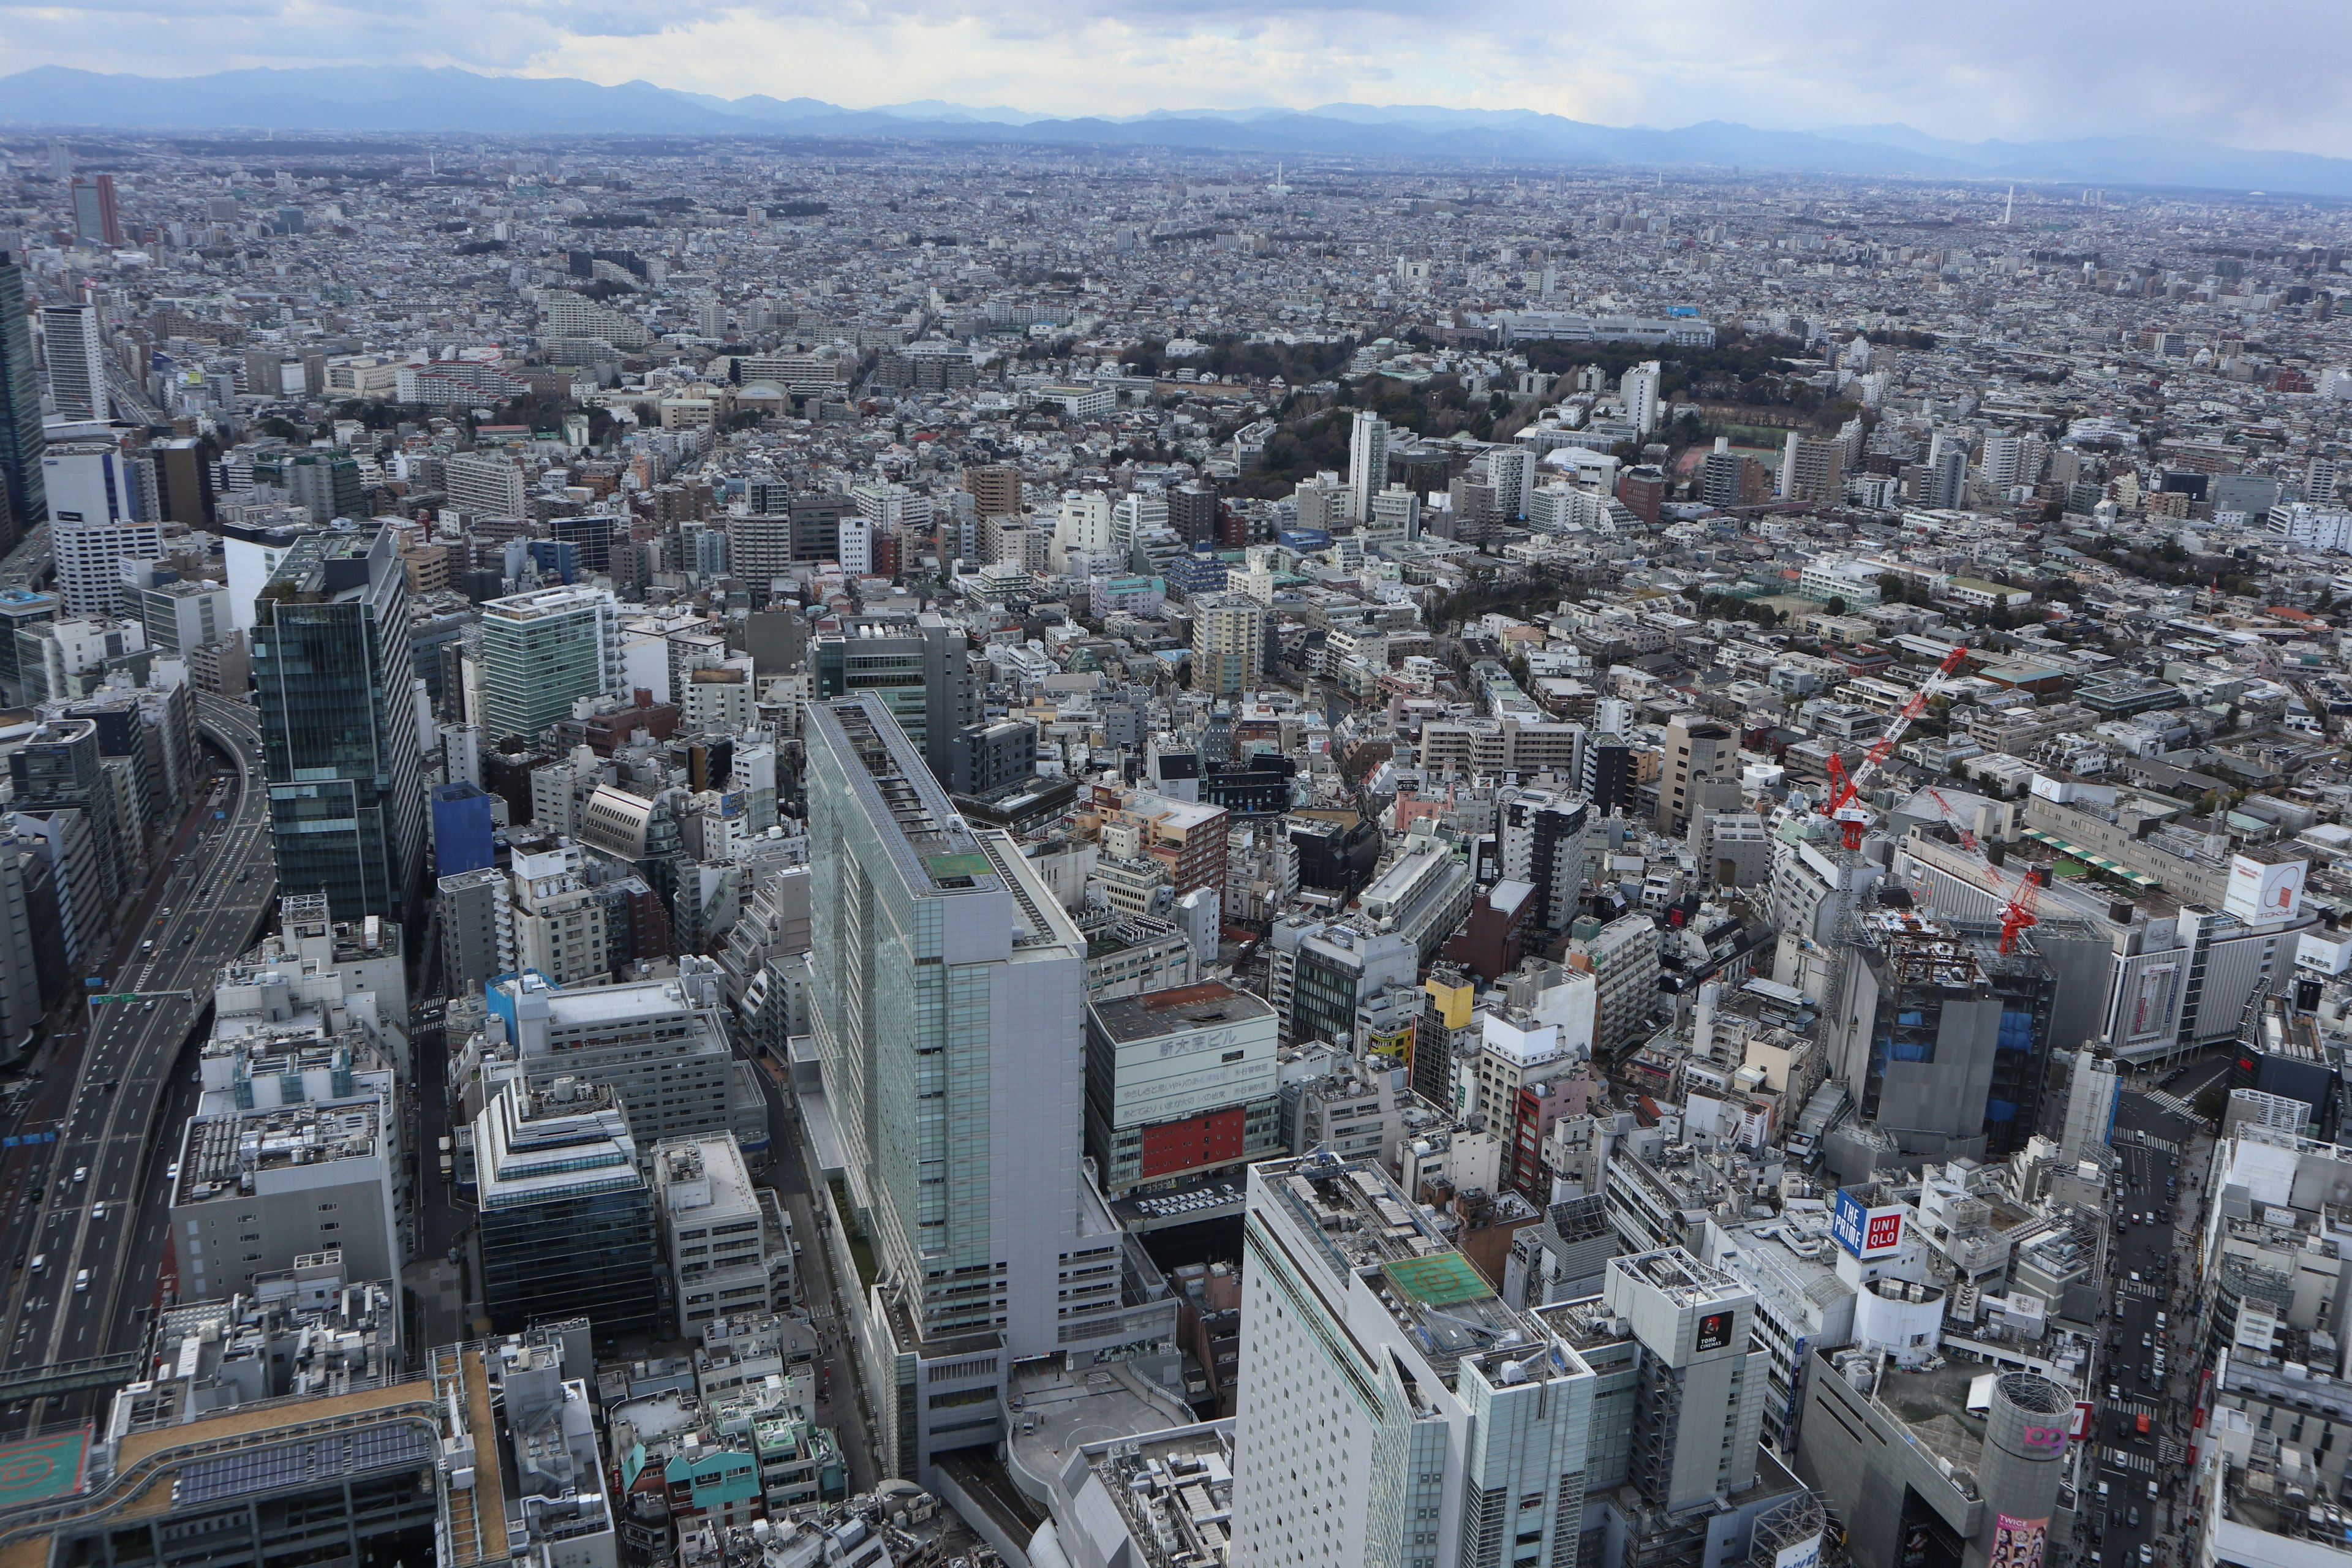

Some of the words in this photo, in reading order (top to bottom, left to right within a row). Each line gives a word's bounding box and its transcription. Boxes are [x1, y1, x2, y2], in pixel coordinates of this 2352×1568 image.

[1159, 1030, 1237, 1057] 新大宗ビル
[1523, 1052, 1555, 1065] 井門ビル
[1844, 1200, 1860, 1227] THE
[1834, 1214, 1861, 1250] PRIME
[1872, 1218, 1896, 1232] UNI
[1871, 1232, 1895, 1246] QLO
[1700, 1341, 1722, 1349] CINEMAS
[2023, 1425, 2067, 1455] 109
[1999, 1514, 2027, 1527] TWICE
